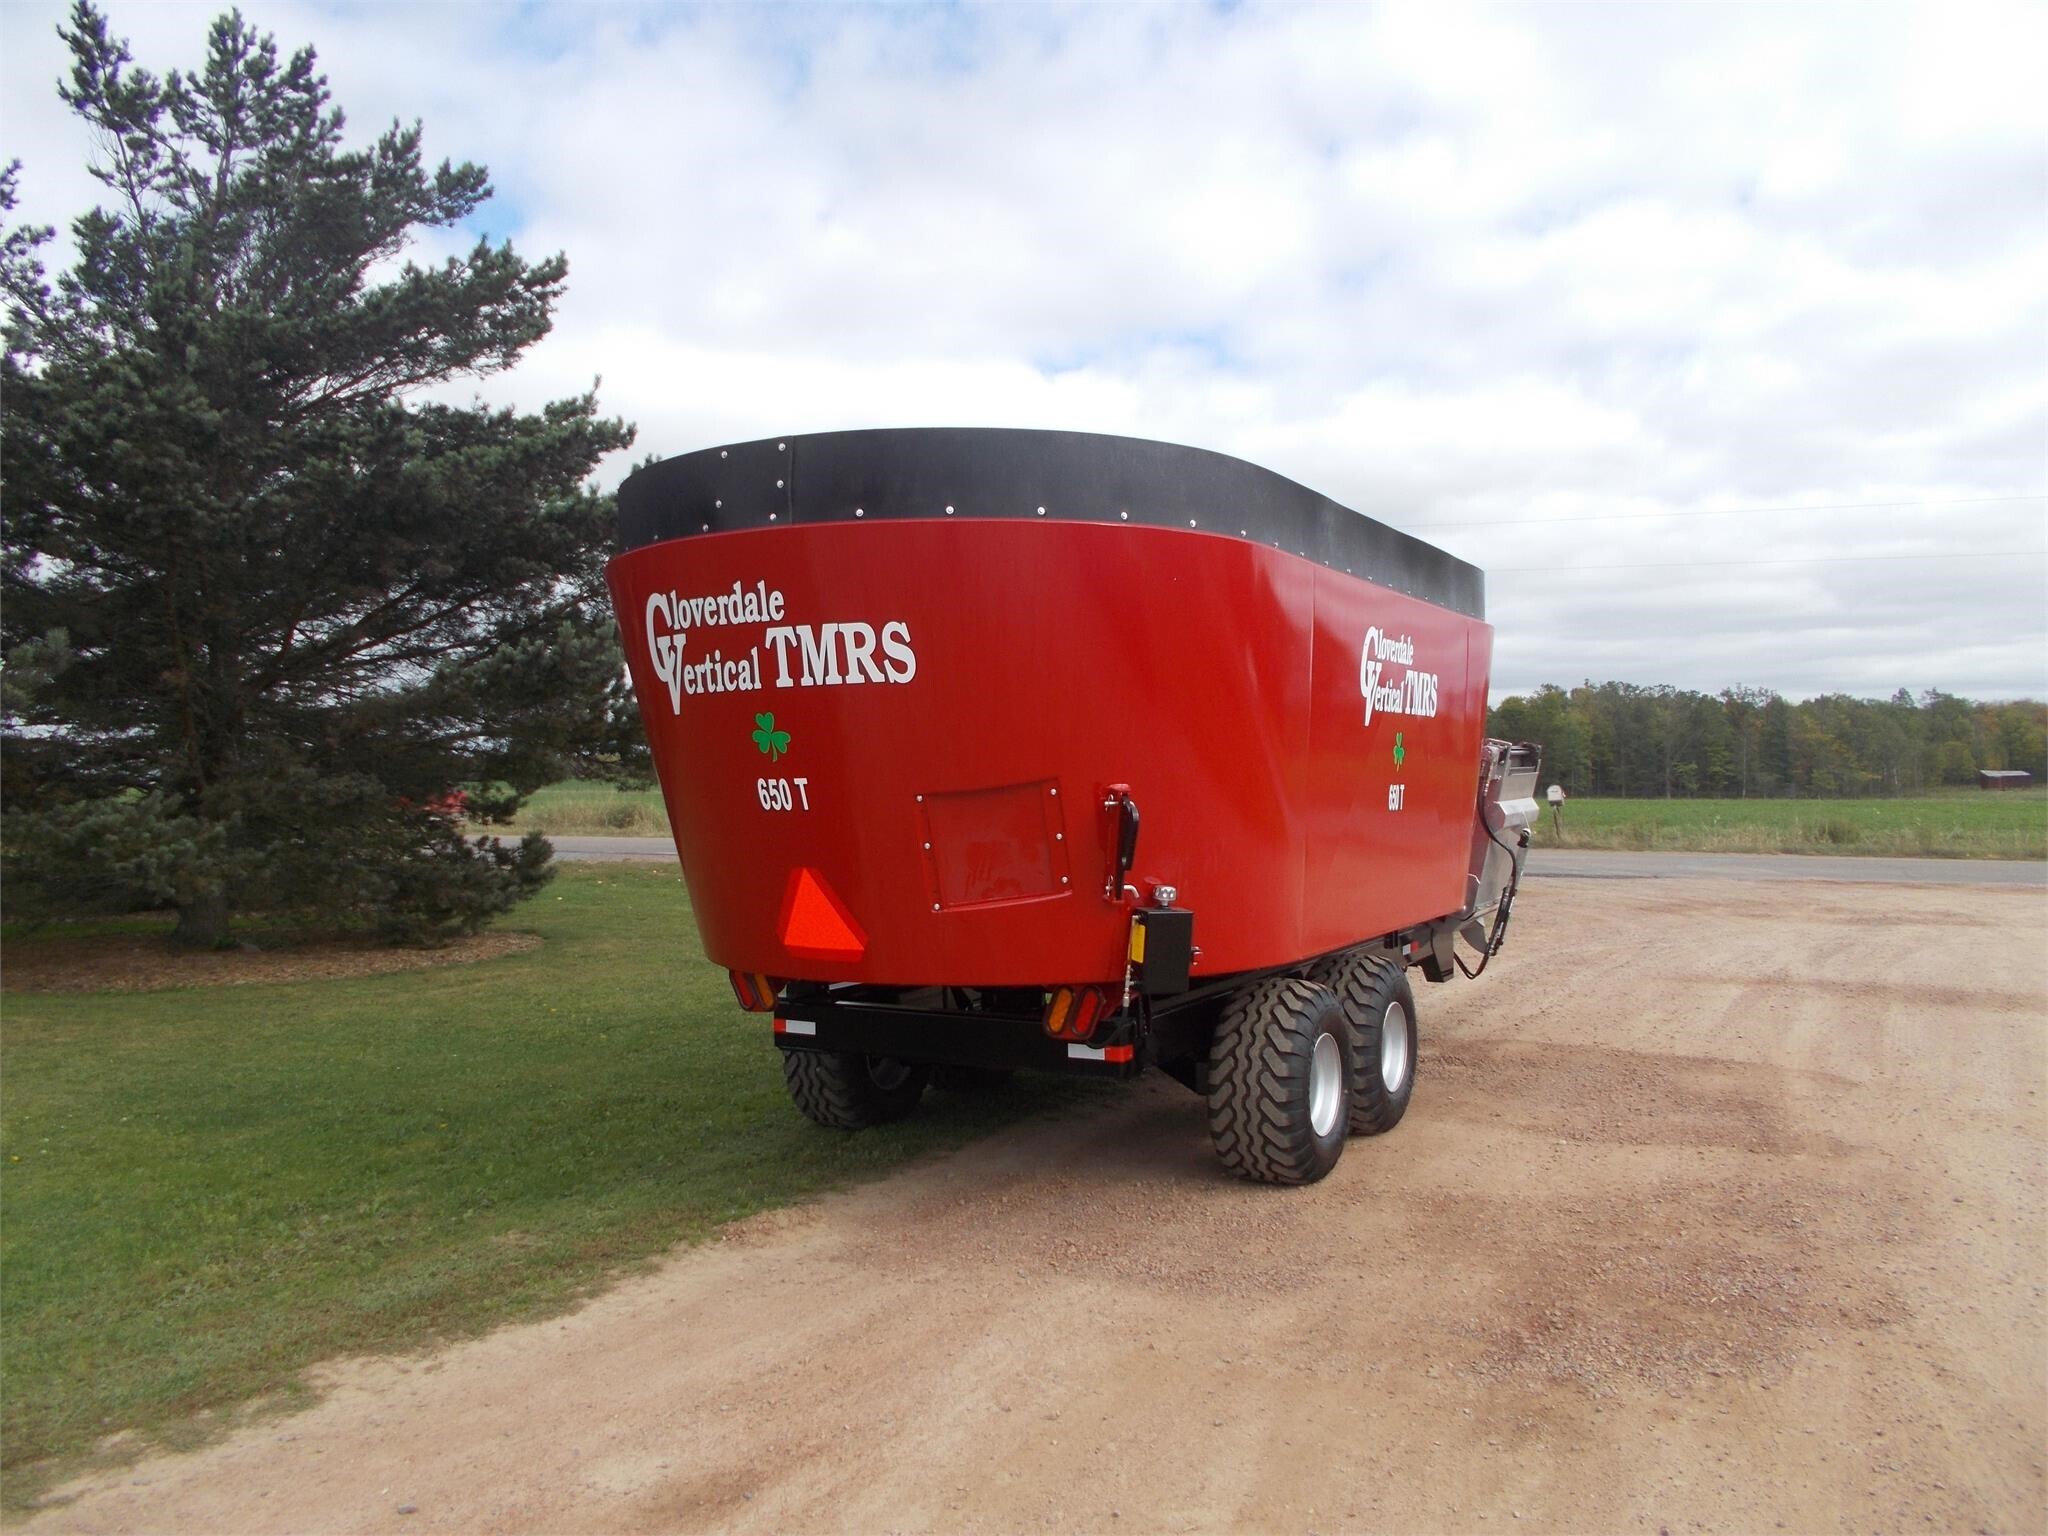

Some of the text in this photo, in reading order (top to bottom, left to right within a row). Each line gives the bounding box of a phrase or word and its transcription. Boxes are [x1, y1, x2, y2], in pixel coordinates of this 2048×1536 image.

[646, 579, 785, 682] Cloverdale
[1360, 626, 1413, 698] Cloverdale
[656, 621, 917, 716] Vertical TMRS
[1364, 660, 1438, 727] Vertical TMRS
[757, 777, 809, 811] 650 T
